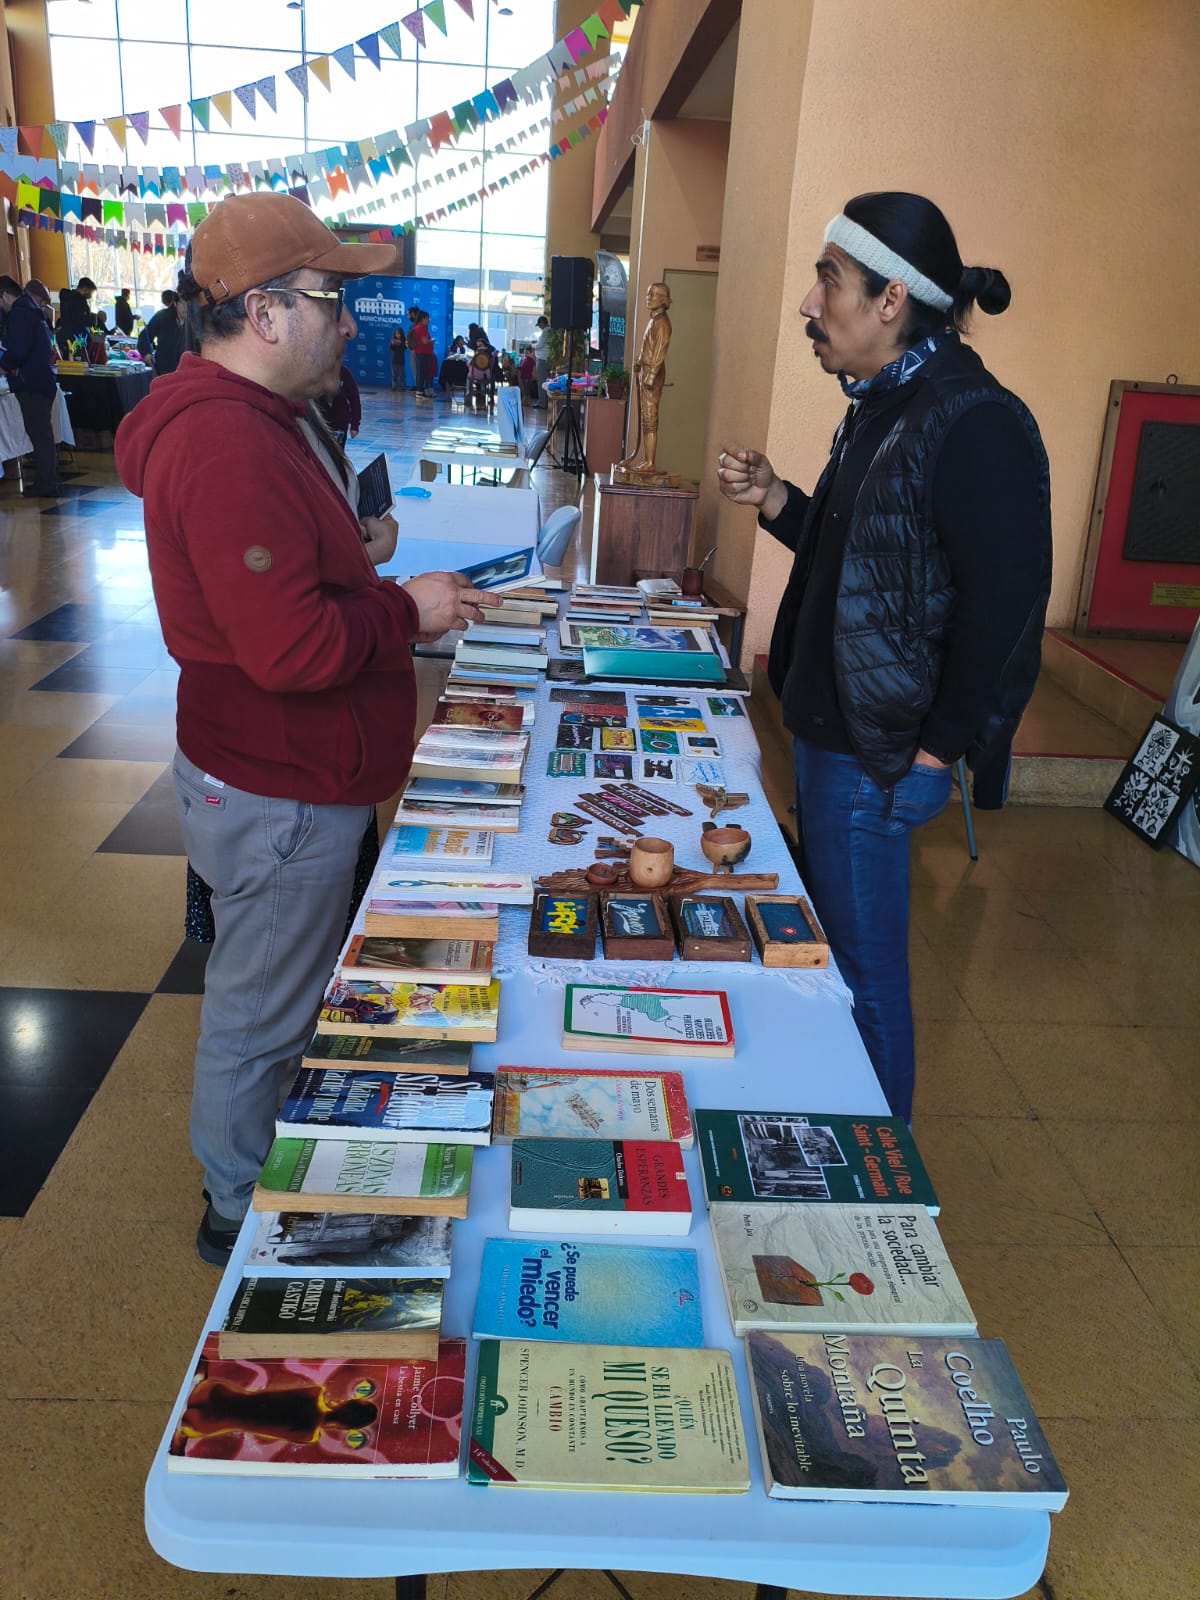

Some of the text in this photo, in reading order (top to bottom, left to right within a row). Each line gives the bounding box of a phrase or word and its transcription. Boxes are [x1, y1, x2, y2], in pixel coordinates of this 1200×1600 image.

[359, 315, 402, 324] MUNICIPALIDAD
[701, 912, 718, 936] TALLER
[306, 1097, 340, 1121] noche
[342, 1080, 382, 1114] Mañana,
[383, 1073, 440, 1127] Sheldon
[432, 1080, 482, 1121] Sidney
[630, 1080, 642, 1114] de mayo
[645, 1080, 660, 1132] Dos semanas
[850, 1123, 874, 1146] Saint
[862, 1155, 890, 1197] Germain
[875, 1126, 899, 1149] Calle
[883, 1149, 906, 1168] Viel
[335, 1140, 373, 1193] RRONEAS
[365, 1156, 394, 1194] ZONAS
[617, 1169, 625, 1187] Dickens
[636, 1148, 652, 1205] ESPERANZAS
[652, 1155, 669, 1198] GRANDES
[892, 1174, 913, 1195] Rue
[540, 1248, 552, 1258] el
[560, 1242, 580, 1301] ¿Se puede
[877, 1215, 917, 1285] la sociedad...
[898, 1215, 940, 1288] Para cambiar
[278, 1281, 303, 1320] CASTIGO
[302, 1279, 325, 1313] CRIMEN
[517, 1257, 543, 1328] miedo?
[543, 1270, 561, 1330] vencer
[796, 1354, 813, 1402] Una novela
[908, 1350, 924, 1368] La
[396, 1376, 407, 1397] bestia
[407, 1365, 426, 1430] Jaime Collyer
[514, 1347, 530, 1471] SPENCER JOHNSON, M.D.
[548, 1385, 563, 1432] CAMBIO
[823, 1333, 866, 1438] Montaña
[946, 1352, 995, 1446] Coelho
[567, 1413, 575, 1454] CONSTANTE
[579, 1396, 587, 1439] ADAPTARNOS
[592, 1360, 653, 1464] MI QUESO?
[651, 1366, 678, 1460] SE HA LLEVADO
[674, 1393, 699, 1431] ¿QUIÉN
[780, 1369, 813, 1472] sobre lo inevitable
[866, 1362, 929, 1485] Quinta
[1006, 1416, 1044, 1474] Paulo
